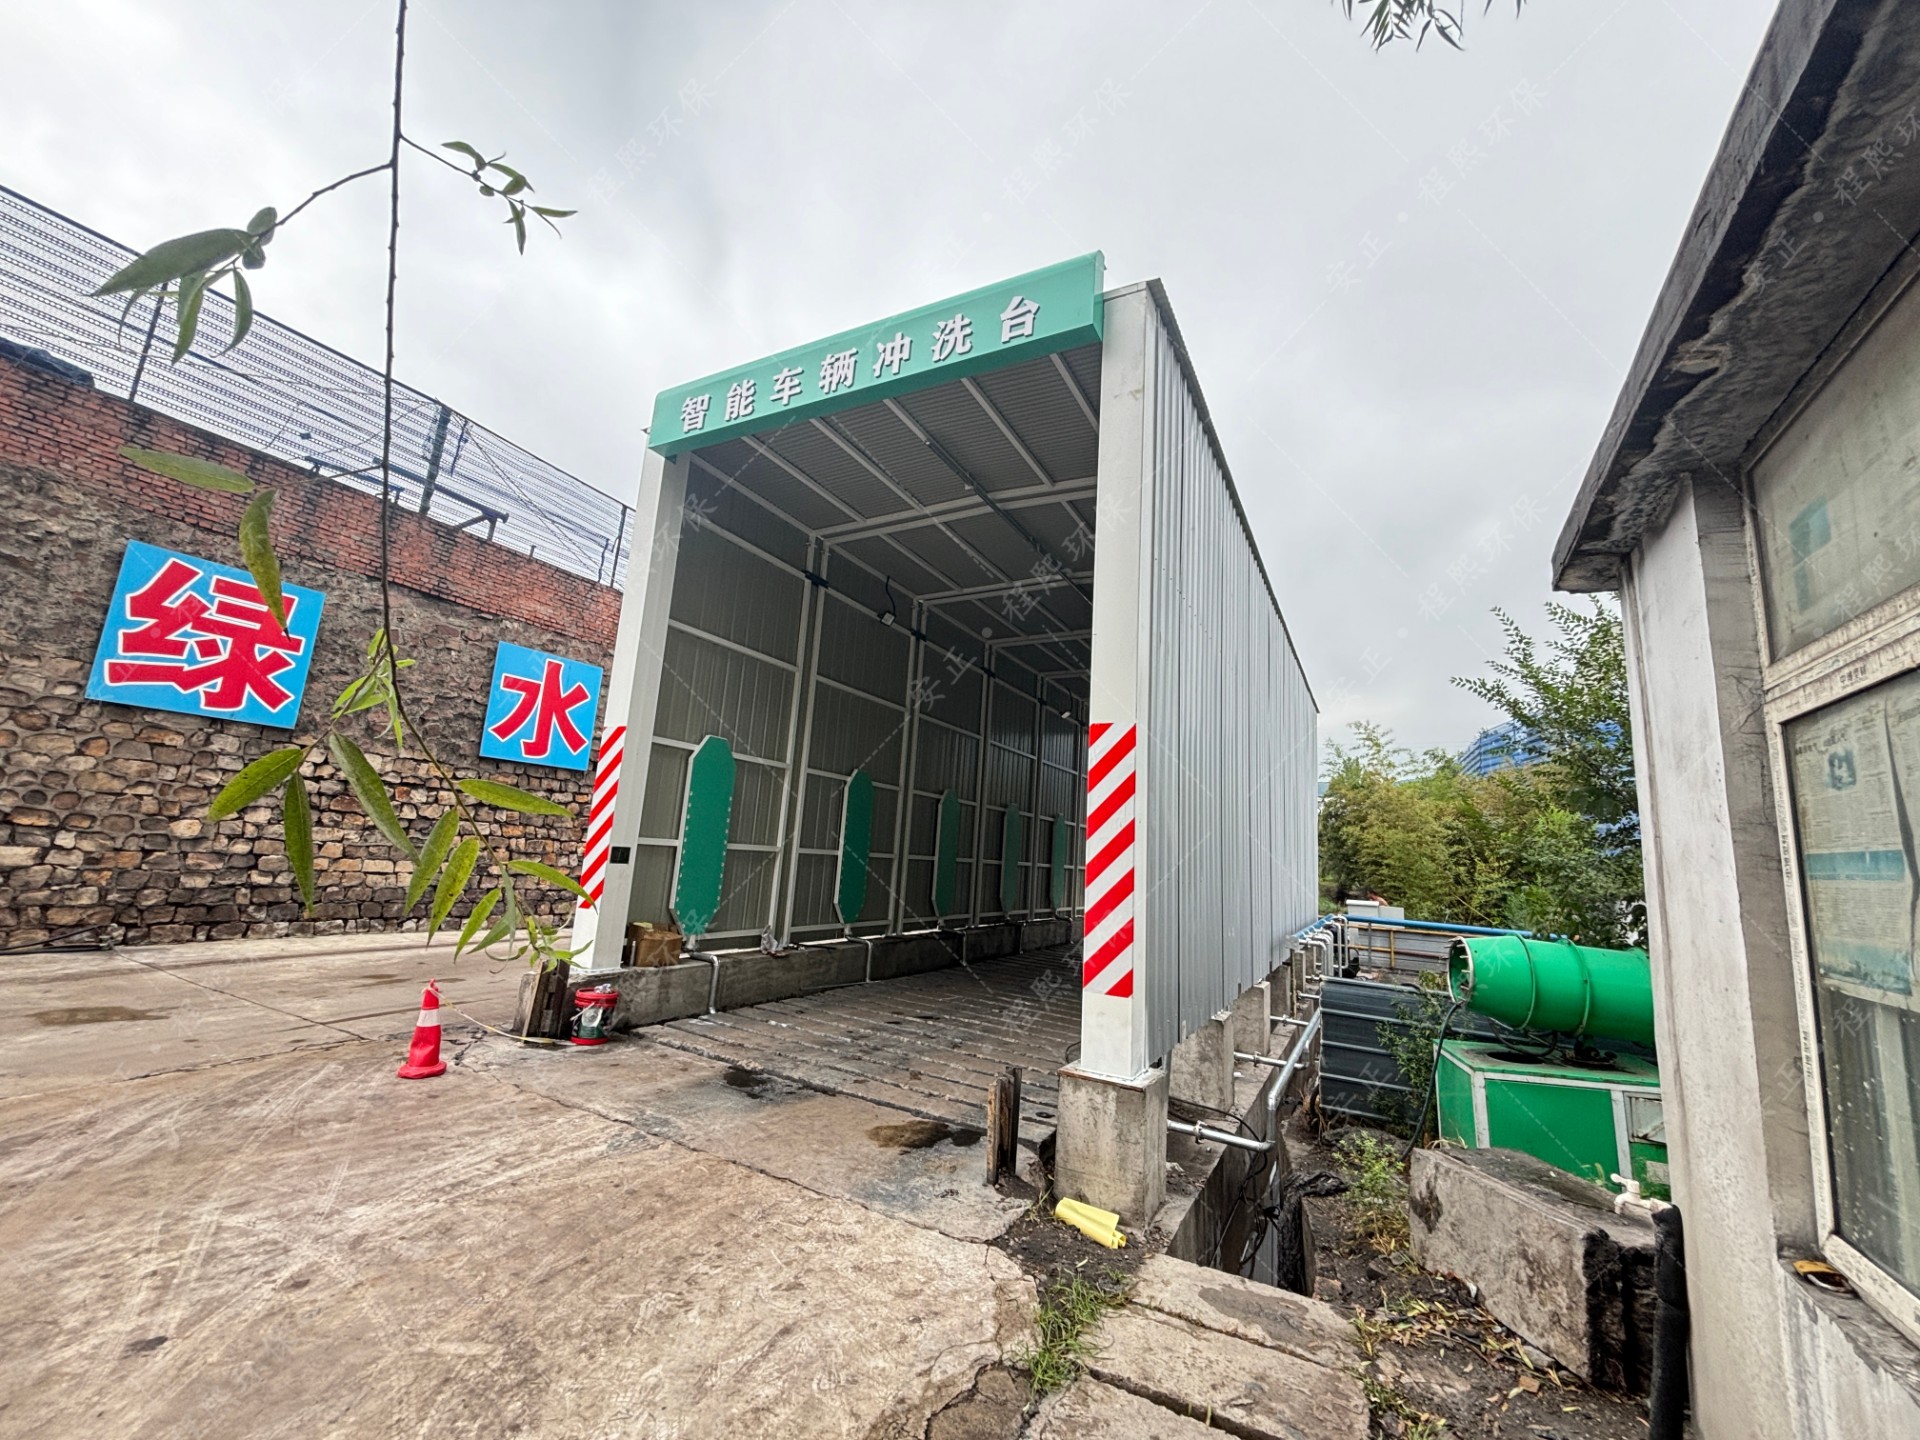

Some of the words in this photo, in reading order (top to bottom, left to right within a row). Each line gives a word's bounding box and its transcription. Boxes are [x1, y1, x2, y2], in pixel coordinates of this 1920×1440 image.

[680, 295, 1041, 433] 智能车辆冲洗台
[104, 558, 305, 713] 绿
[488, 659, 590, 758] 水
